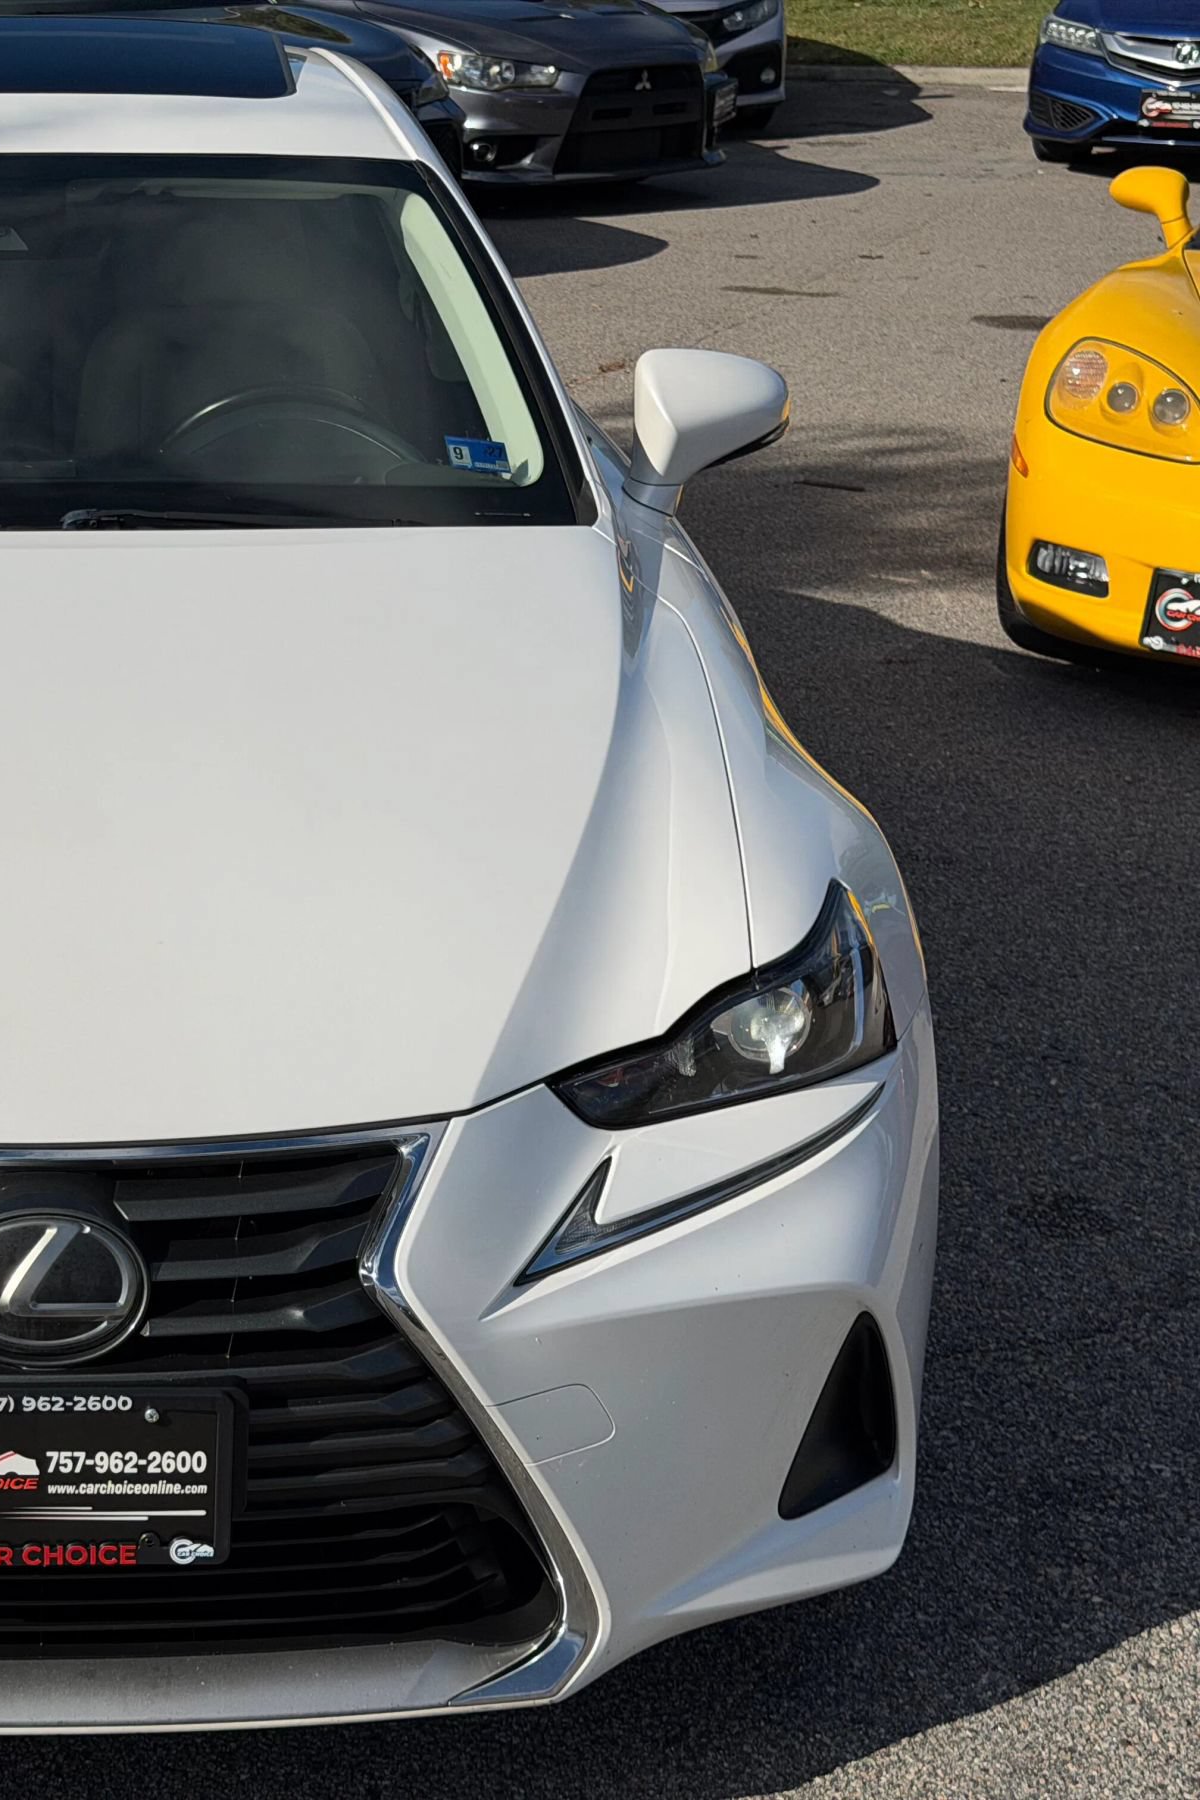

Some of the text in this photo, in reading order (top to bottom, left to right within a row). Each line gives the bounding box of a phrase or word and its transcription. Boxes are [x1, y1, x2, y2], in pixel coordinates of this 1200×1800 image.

[453, 447, 463, 460] 9
[21, 1395, 133, 1412] 962-2600
[46, 1450, 207, 1474] 757-962-2600
[47, 1480, 208, 1494] www.carchoiceonline.com
[21, 1544, 138, 1567] CHOICE
